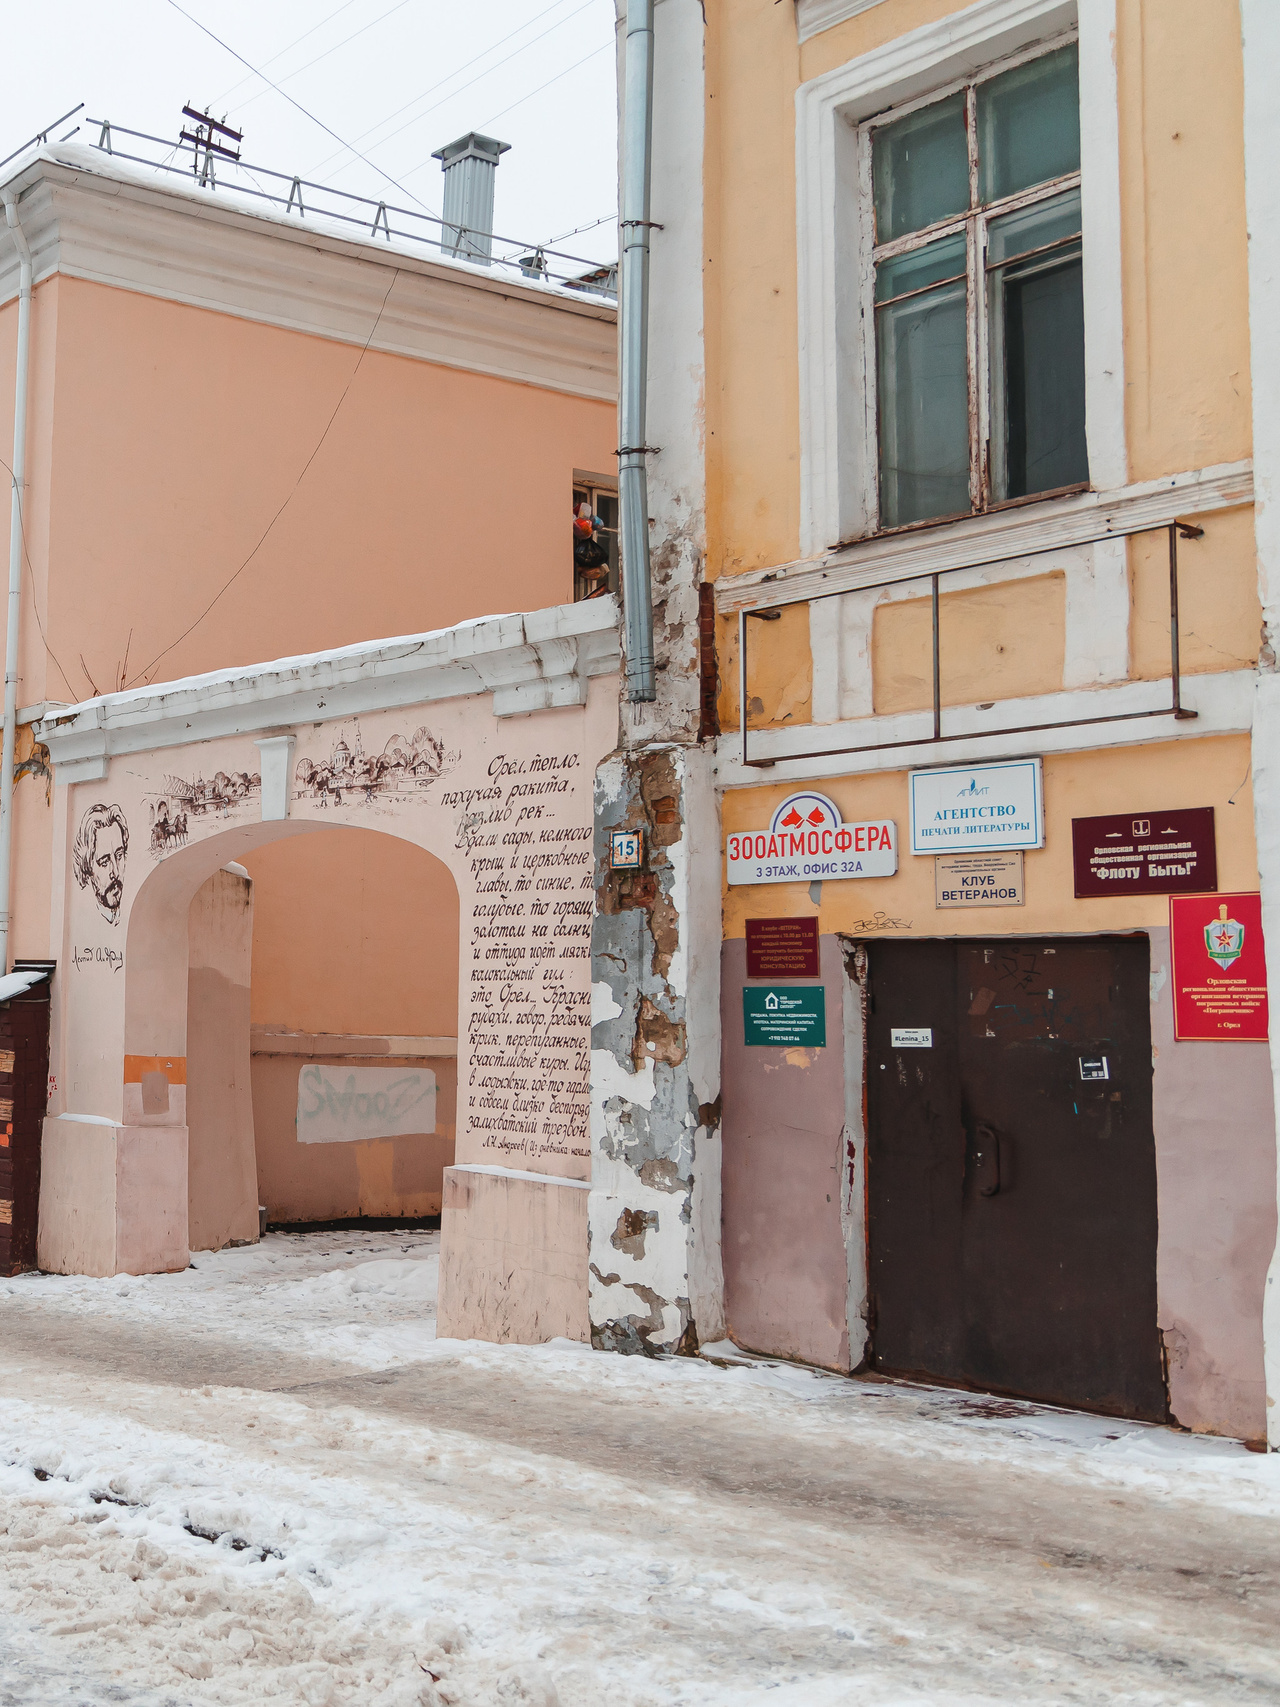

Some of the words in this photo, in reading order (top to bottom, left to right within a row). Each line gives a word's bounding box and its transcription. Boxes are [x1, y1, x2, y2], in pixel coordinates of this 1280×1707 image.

[441, 785, 502, 811] пахучая
[934, 804, 1016, 821] АГЕНТСТВО
[539, 826, 592, 843] немного
[921, 826, 961, 837] ПЕЧАТИ
[962, 822, 1030, 834] ЛИТЕРАТУРЫ
[617, 841, 635, 856] 15
[729, 825, 892, 861] ЗООАТМОСФЕРА
[1094, 845, 1134, 855] Орловская
[1137, 841, 1192, 852] региональная
[470, 857, 505, 880] крыш
[509, 856, 519, 869] и
[522, 844, 590, 877] церковные
[1089, 854, 1144, 864] общественная
[1147, 851, 1197, 861] организация
[756, 867, 763, 878] 3
[765, 864, 800, 877] ЭТАЖ,
[803, 862, 838, 875] ОФИС
[841, 860, 863, 873] 32А
[1090, 866, 1140, 880] "Флоту
[1148, 861, 1197, 877] Быть!"
[514, 874, 532, 892] то
[962, 875, 995, 887] КЛУБ
[942, 888, 1017, 901] ВЕТЕРАНОВ
[530, 898, 551, 915] то
[531, 924, 548, 937] на
[473, 948, 481, 960] и
[485, 943, 526, 967] оттуда
[529, 941, 556, 967] идёт
[1206, 977, 1247, 986] Орловская
[470, 985, 492, 1003] это
[1202, 1007, 1254, 1015] «Пограничник»
[1223, 1021, 1241, 1029] Орел
[895, 1035, 929, 1043] #Lenina_15
[469, 1048, 538, 1068] счастливые
[468, 1067, 477, 1086] в
[531, 1078, 564, 1099] где-то
[468, 1095, 476, 1107] и
[479, 1090, 510, 1110] совсем
[512, 1092, 545, 1119] близко
[466, 1112, 537, 1134] залихватский
